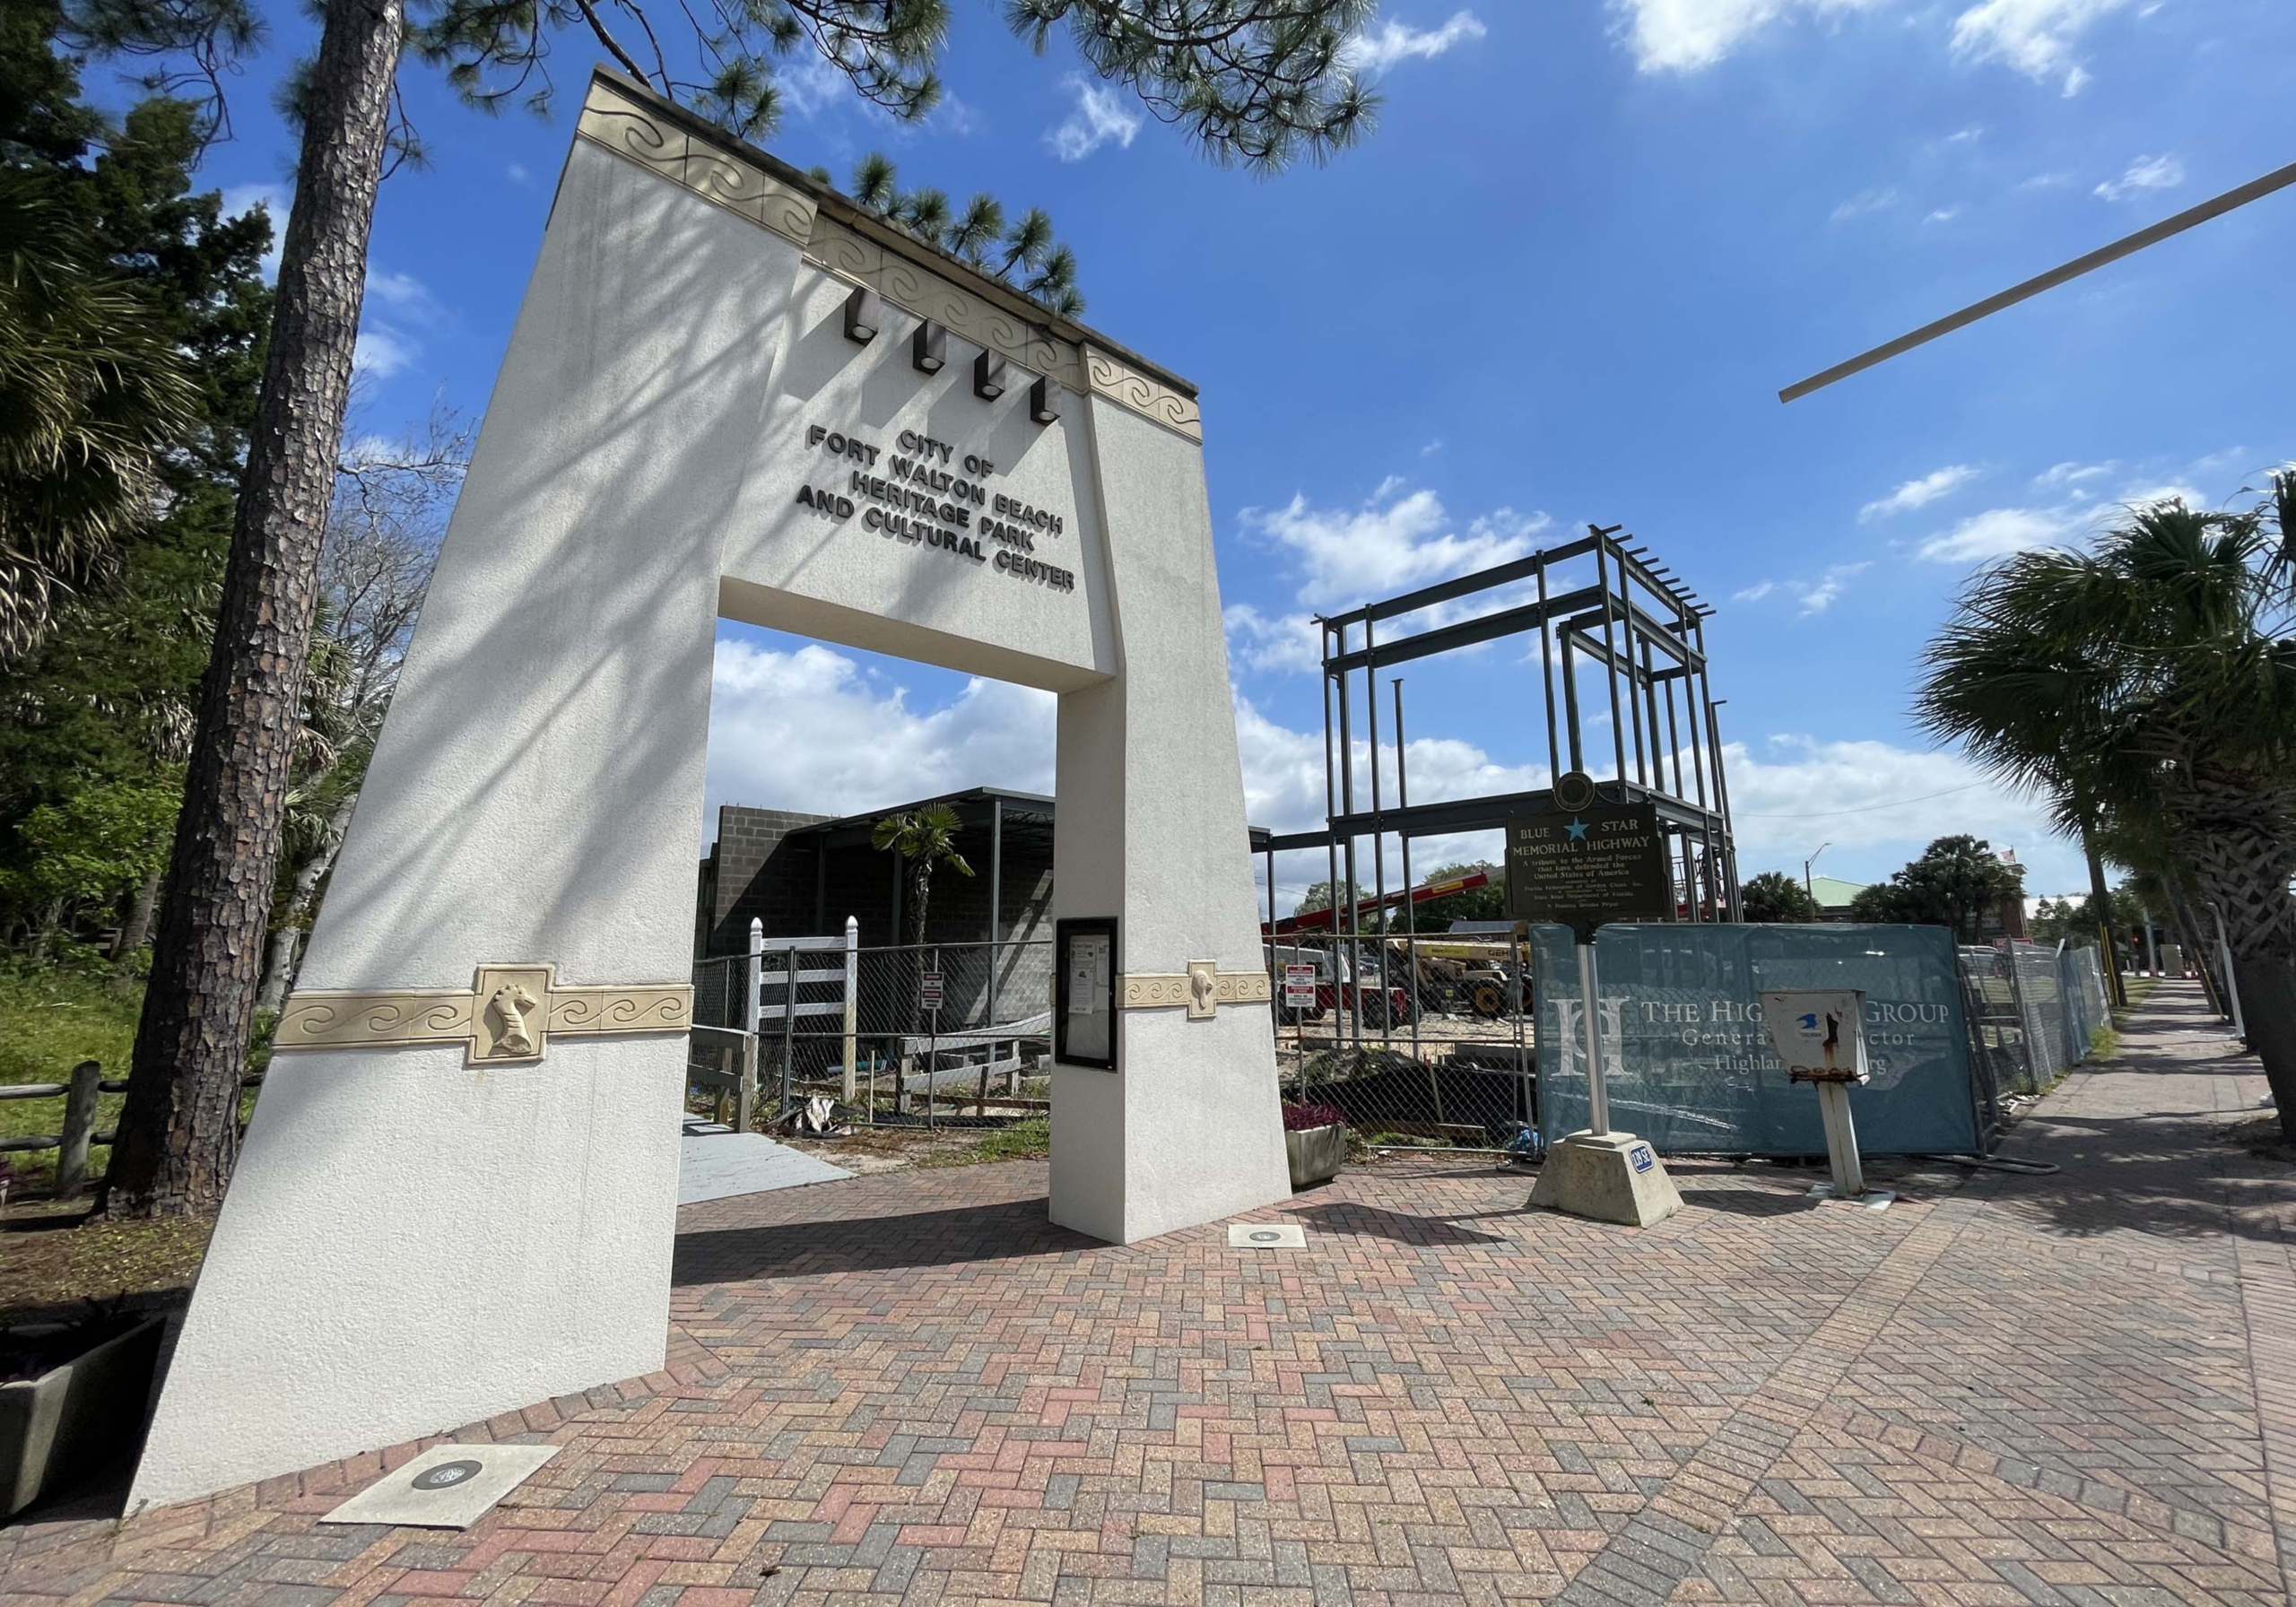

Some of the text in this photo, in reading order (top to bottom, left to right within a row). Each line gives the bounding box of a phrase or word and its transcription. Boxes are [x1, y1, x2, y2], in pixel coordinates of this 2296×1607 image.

[898, 429, 995, 479] CITY OF
[809, 423, 1064, 535] FORT WALTON BEACH
[852, 470, 1035, 552] HERITAGE PARK
[796, 484, 1075, 591] AND CULTURAL CENTER
[1520, 819, 1639, 839] BLUE STAR
[1513, 836, 1650, 856] MEMORIAL HIGHWAY
[1532, 858, 1556, 866] tribute
[1587, 854, 1613, 863] Armed
[1615, 853, 1642, 861] Forces
[1575, 862, 1609, 871] defended
[1560, 871, 1584, 879] States
[1641, 1001, 1700, 1023] THE
[1866, 1000, 1949, 1023] GROUP
[1682, 1029, 1769, 1047] Genera
